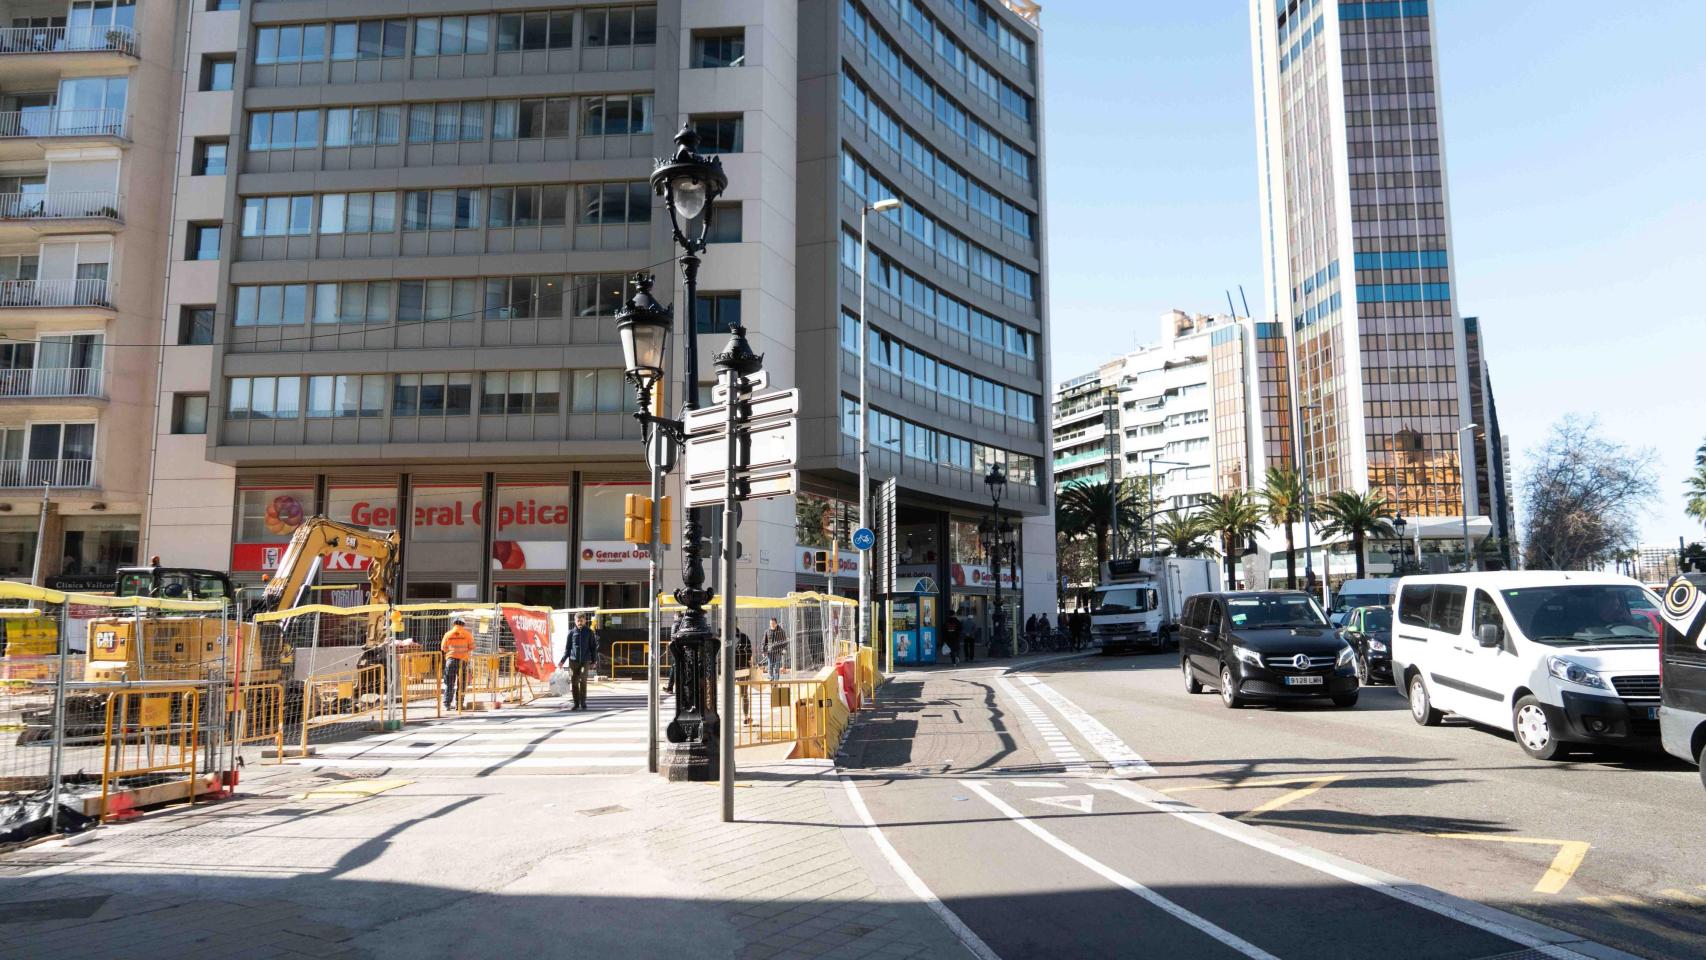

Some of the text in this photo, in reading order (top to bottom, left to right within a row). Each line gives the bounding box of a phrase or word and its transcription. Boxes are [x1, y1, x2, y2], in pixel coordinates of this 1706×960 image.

[327, 551, 369, 569] KF
[596, 550, 630, 559] General
[96, 632, 114, 648] CAT
